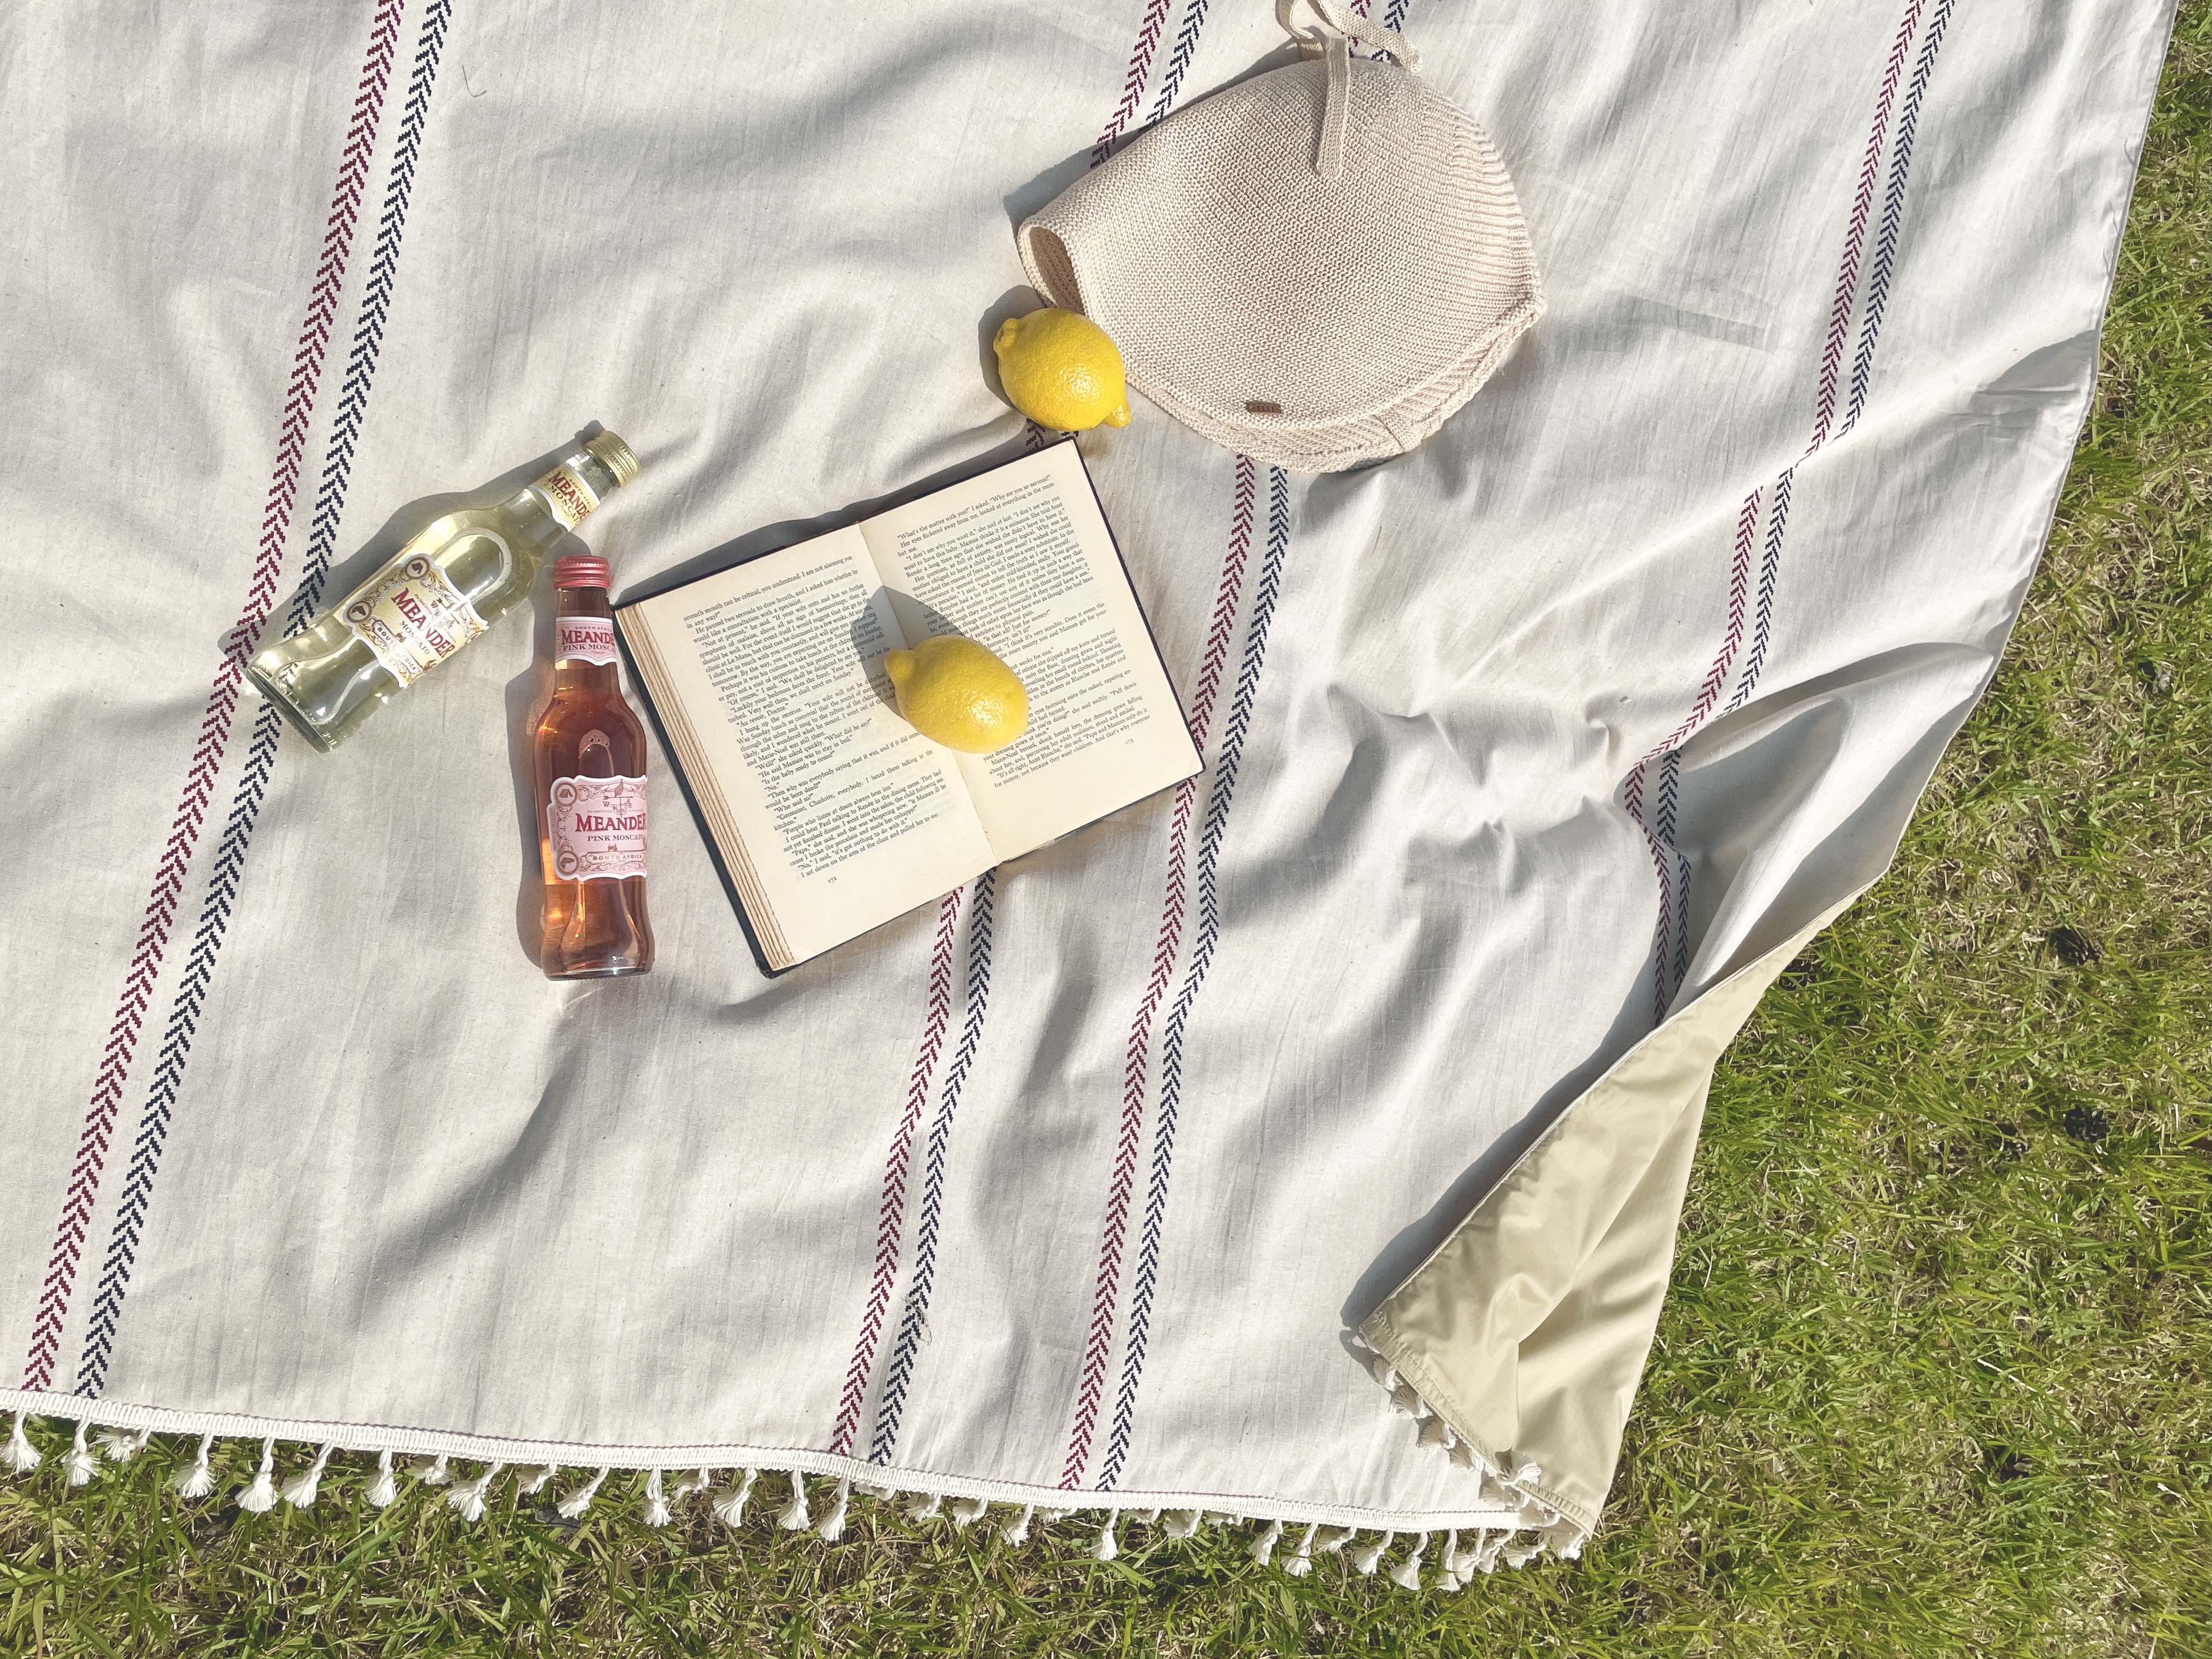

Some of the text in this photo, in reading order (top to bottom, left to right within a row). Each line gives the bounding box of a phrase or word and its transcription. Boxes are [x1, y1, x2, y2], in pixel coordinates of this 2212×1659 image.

[569, 479, 583, 496] SOUTH
[911, 536, 923, 544] eyes
[922, 526, 943, 539] flickered
[944, 522, 956, 531] away
[956, 517, 969, 525] from
[978, 505, 996, 516] looked
[1002, 494, 1027, 507] everything
[928, 519, 945, 529] matter
[945, 513, 957, 522] with
[975, 499, 990, 510] asked.
[683, 609, 705, 622] seventh
[704, 602, 724, 614] month
[741, 588, 762, 600] critical,
[761, 585, 772, 594] you
[772, 573, 802, 588] understand.
[824, 558, 844, 569] alarming
[705, 618, 725, 632] paused
[735, 607, 757, 619] seconds
[775, 593, 795, 603] breath,
[795, 588, 805, 596] and
[809, 581, 824, 591] asked
[834, 572, 853, 582] whether
[391, 587, 455, 658] MEANDER
[399, 621, 430, 655] MOSCATO
[692, 632, 711, 643] would
[727, 615, 760, 631] consultation
[760, 609, 773, 618] with
[778, 598, 803, 612] specialist.
[974, 626, 995, 638] antidote
[1001, 613, 1022, 628] physical
[1022, 610, 1034, 619] pain.
[727, 711, 748, 724] turbed.
[747, 706, 761, 715] Very
[762, 701, 774, 710] well
[798, 685, 811, 696] shall
[811, 681, 825, 690] meet
[749, 713, 767, 724] revoir,
[747, 758, 758, 767] and
[757, 745, 788, 762] Marie-Noel
[800, 736, 811, 745] still
[810, 731, 827, 741] there.
[983, 754, 994, 762] your
[995, 745, 1015, 756] dressing
[1014, 739, 1028, 749] gown
[1003, 774, 1021, 785] money,
[1029, 761, 1049, 772] because
[1060, 749, 1073, 758] want
[1073, 741, 1094, 752] children.
[1095, 734, 1105, 743] And
[1130, 715, 1150, 726] everyone
[765, 798, 782, 809] would
[790, 791, 804, 799] born
[808, 794, 835, 808] Charlotte,
[837, 781, 863, 795] everybody.
[870, 770, 886, 781] heard
[887, 765, 900, 774] them
[901, 757, 918, 767] talking
[575, 813, 646, 832] MEANDER
[814, 862, 830, 872] down
[876, 835, 889, 845] chair
[889, 830, 900, 839] and
[900, 822, 916, 835] pulled
